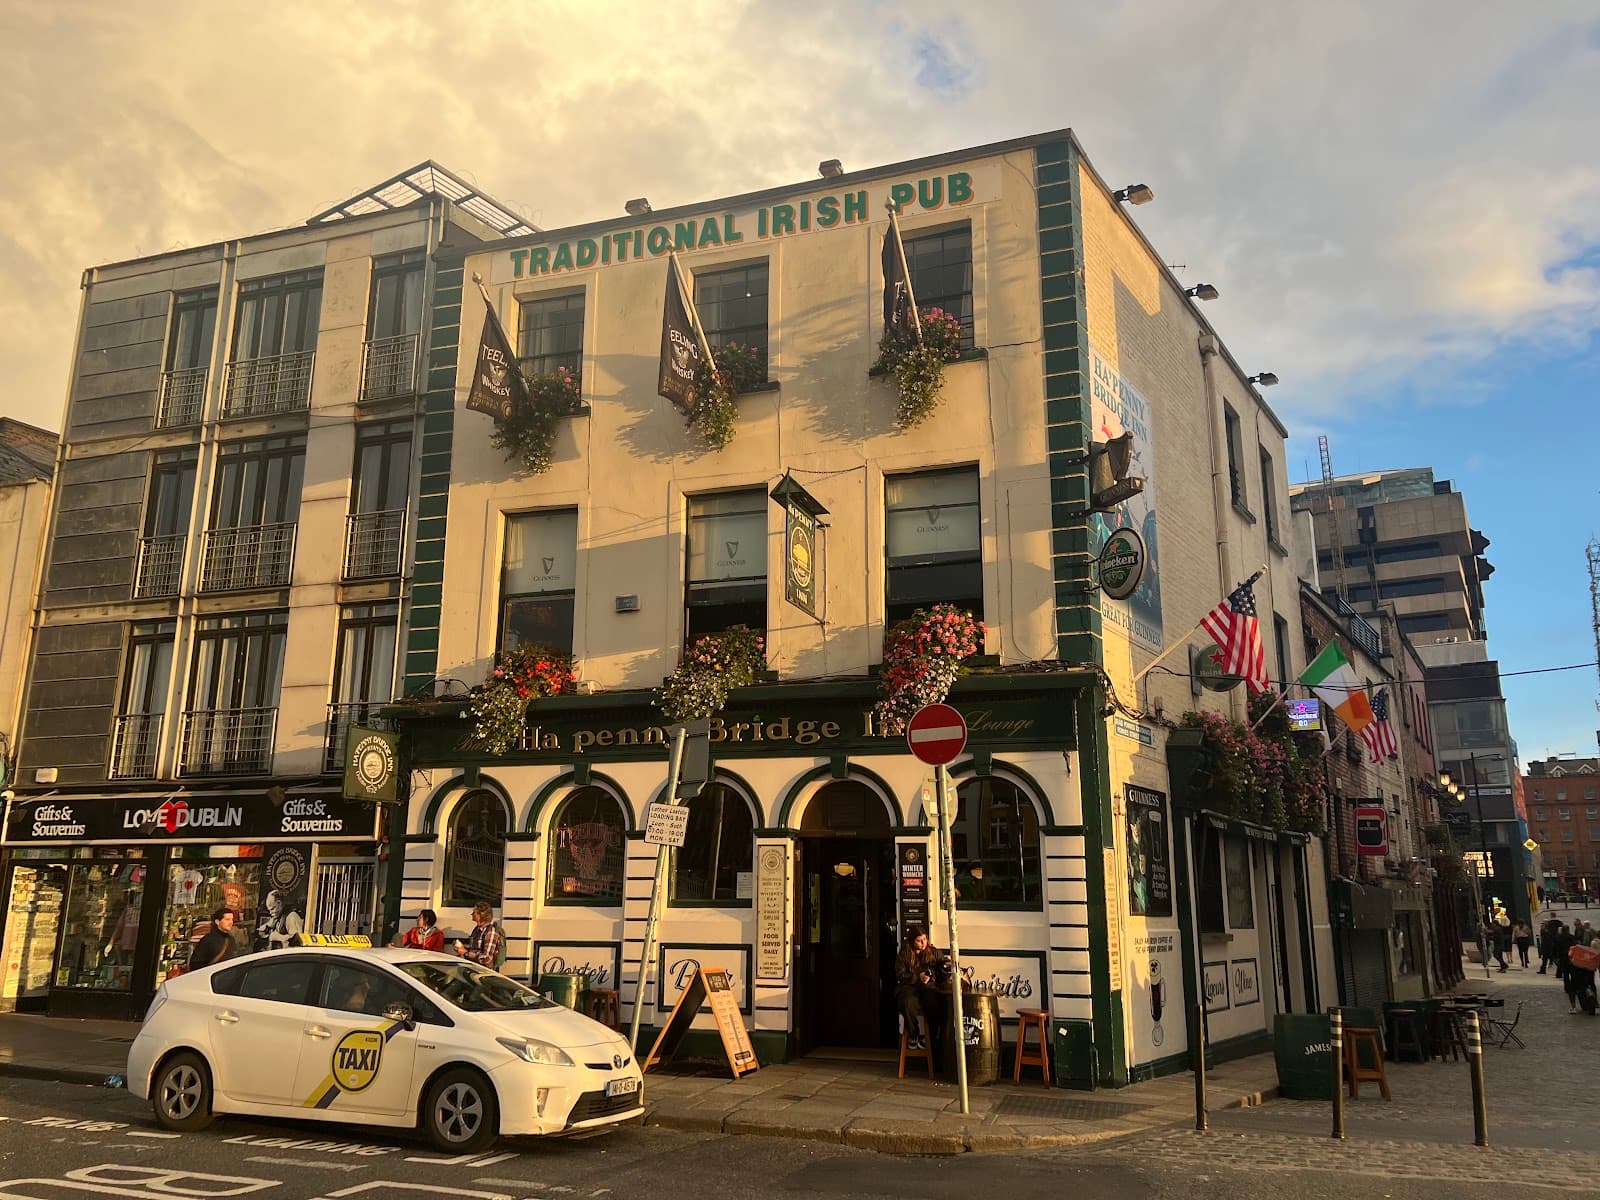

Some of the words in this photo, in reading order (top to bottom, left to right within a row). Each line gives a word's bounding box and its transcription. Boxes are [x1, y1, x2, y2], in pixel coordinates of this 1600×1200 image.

[510, 214, 743, 278] TRADITIONAL
[758, 190, 869, 239] IRISH
[891, 171, 973, 216] PUB
[669, 324, 698, 359] EELING
[482, 373, 510, 397] WHISKEY
[1094, 354, 1145, 421] HA'PENNY
[1094, 377, 1129, 428] BRIDGE
[1131, 415, 1148, 442] INN
[1101, 600, 1120, 625] GREAT
[1122, 614, 1135, 634] FOR
[1134, 621, 1161, 647] GUINNESS
[517, 726, 560, 750] Ha
[708, 716, 841, 745] Bridge
[965, 709, 1035, 737] Lounge
[1129, 789, 1159, 807] GUINNESS
[32, 820, 86, 836] Souvenirs
[175, 801, 242, 828] DUBLIN
[281, 815, 343, 832] Souvenirs
[325, 934, 348, 944] TAXI
[542, 956, 609, 985] Porter
[338, 1047, 377, 1072] TAXI
[220, 1133, 402, 1157] LOADING
